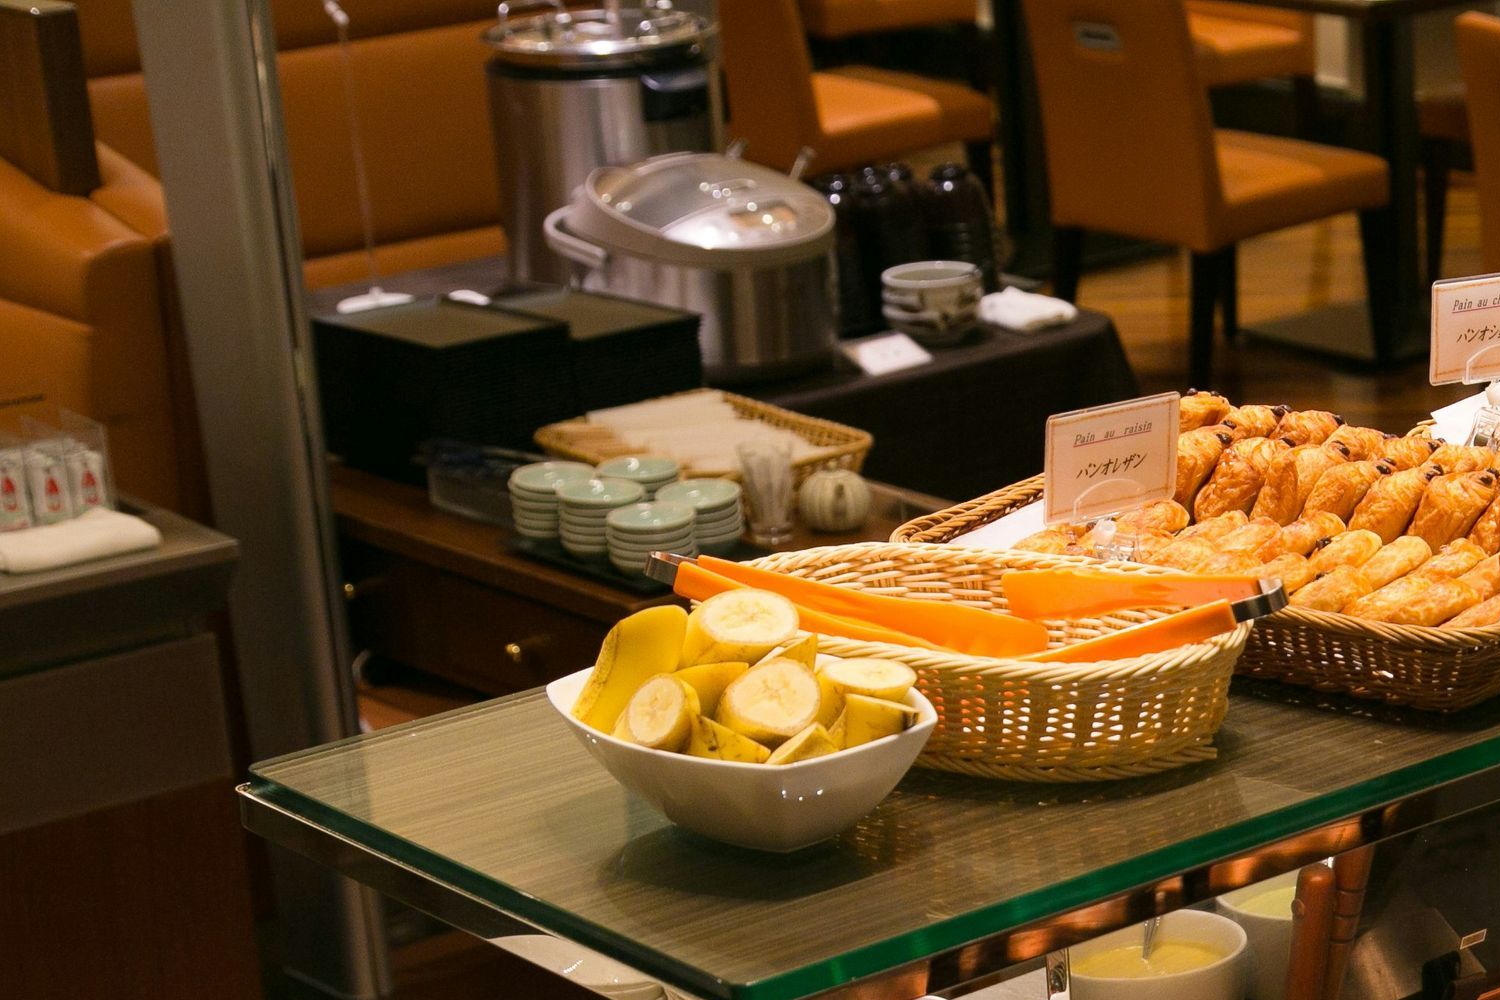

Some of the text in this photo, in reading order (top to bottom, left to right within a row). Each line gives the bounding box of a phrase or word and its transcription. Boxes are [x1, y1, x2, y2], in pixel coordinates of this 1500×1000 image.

[1453, 299, 1472, 310] Pain
[1478, 299, 1488, 307] au
[1074, 421, 1152, 445] Pain au raisin
